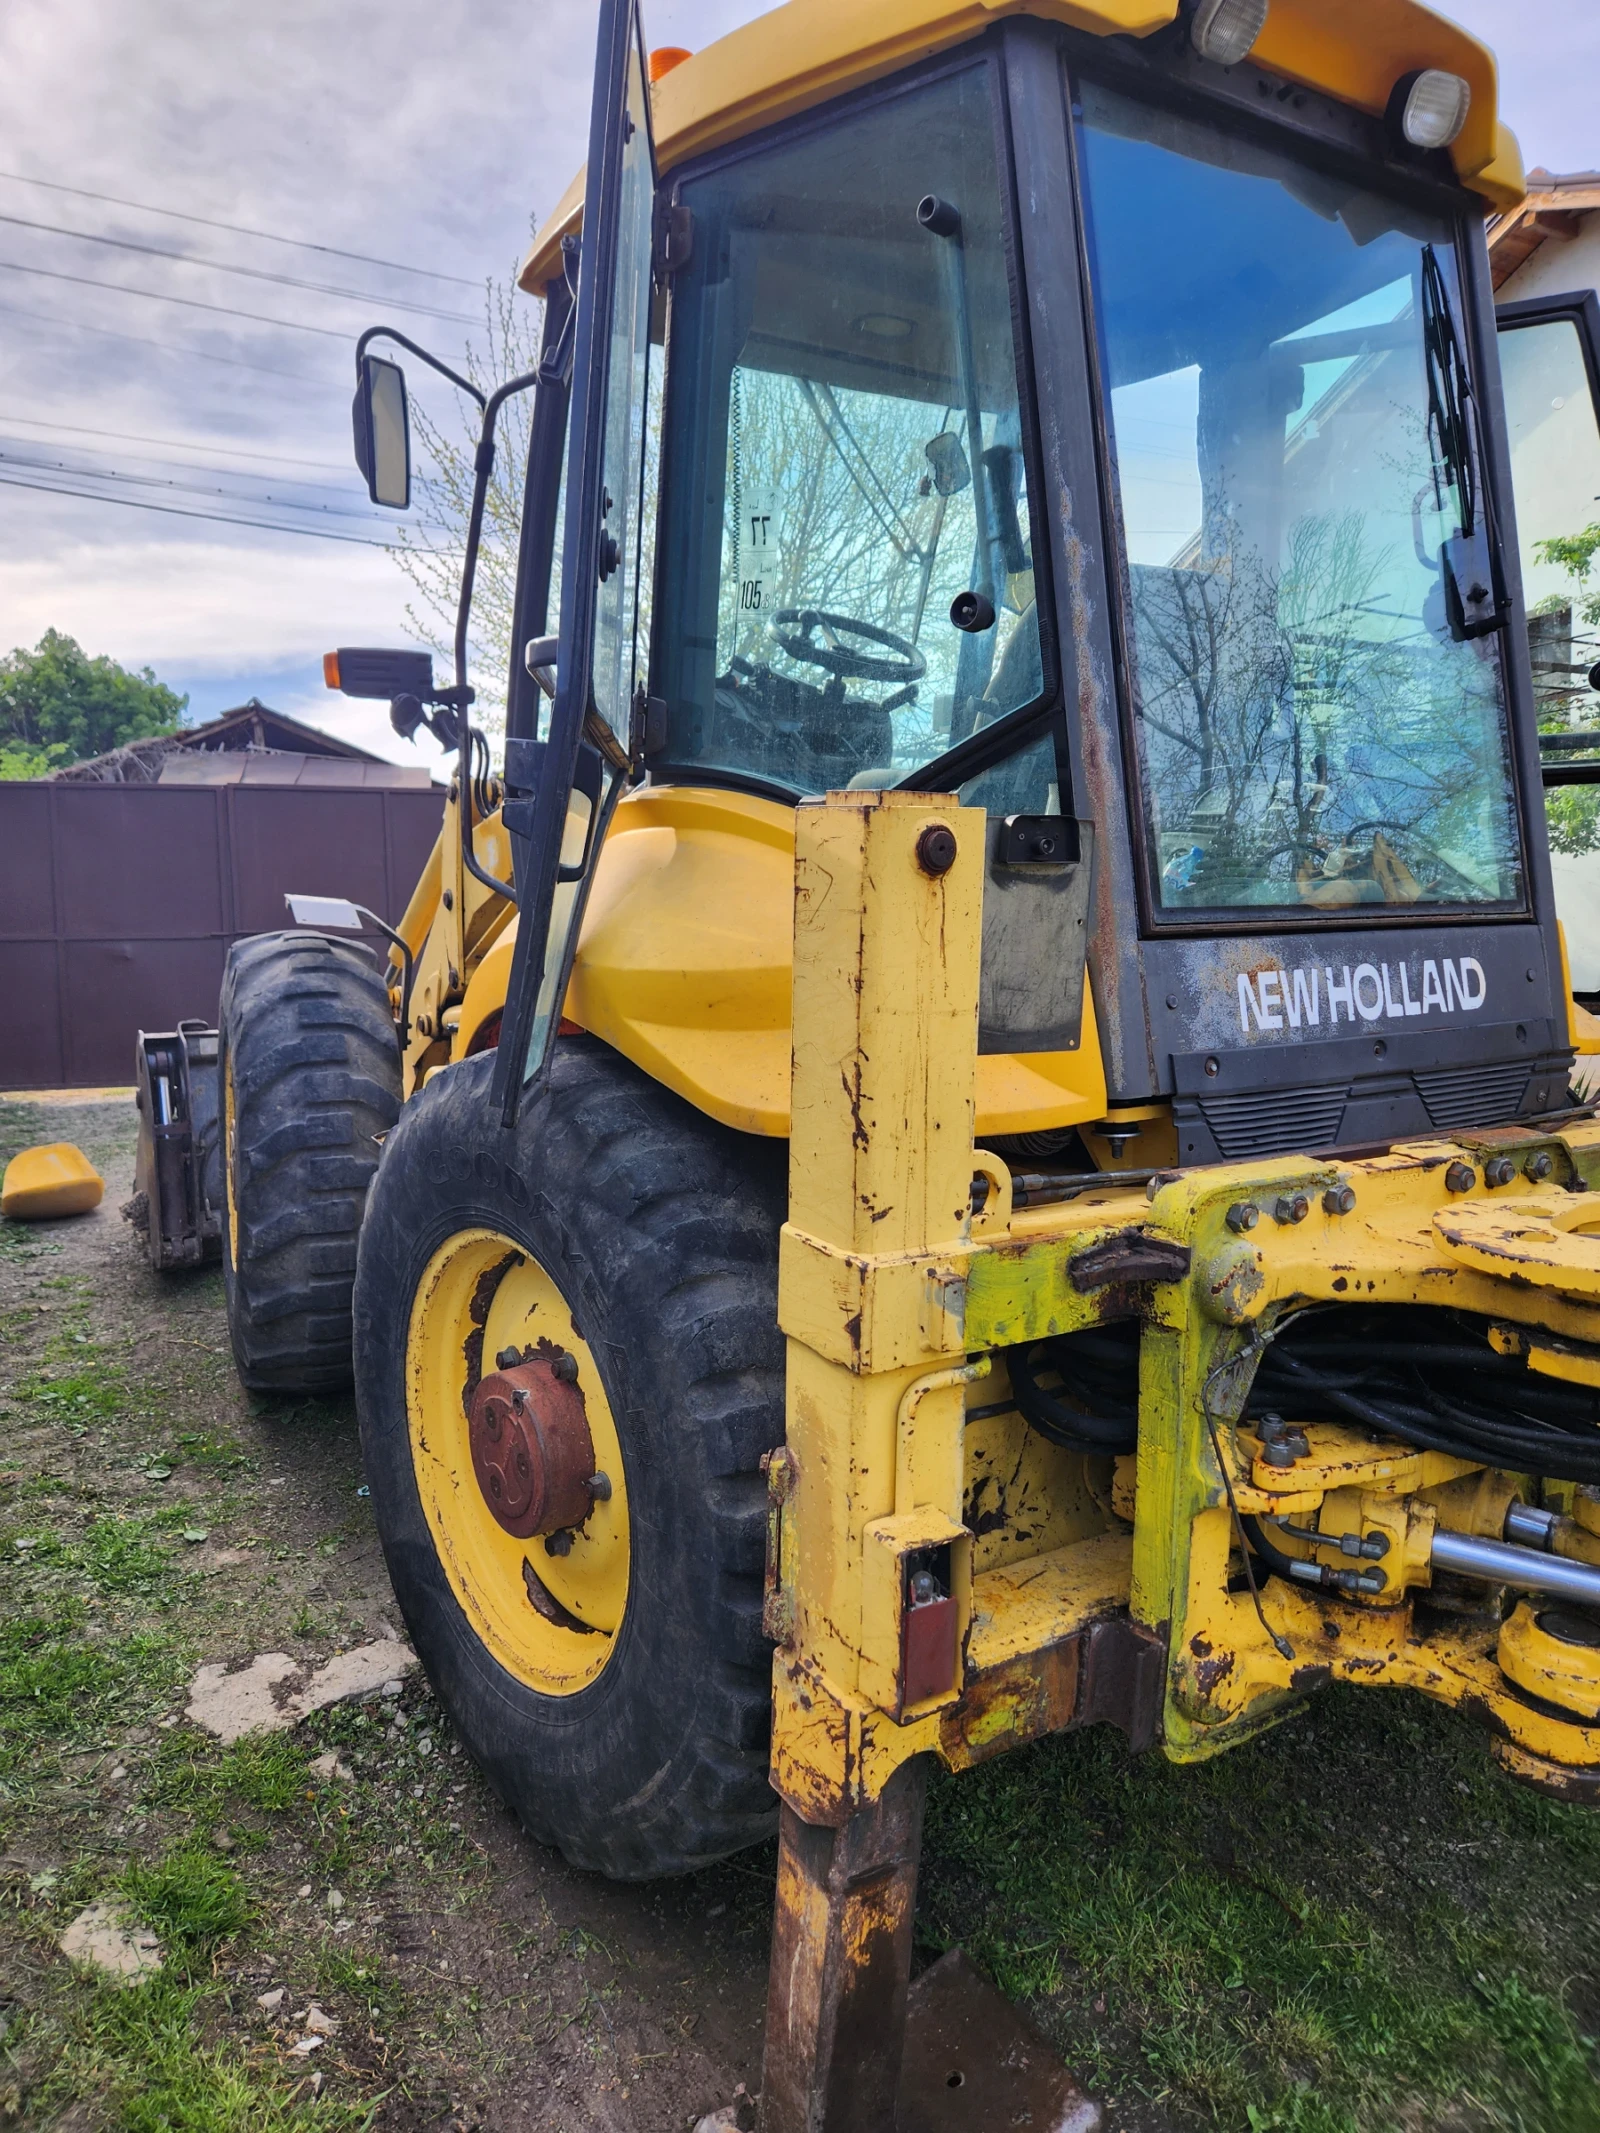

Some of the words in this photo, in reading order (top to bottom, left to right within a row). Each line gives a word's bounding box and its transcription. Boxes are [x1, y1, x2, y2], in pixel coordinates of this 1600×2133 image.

[741, 580, 763, 609] 105
[1236, 967, 1318, 1032] NEW
[1325, 956, 1487, 1022] HOLLAND
